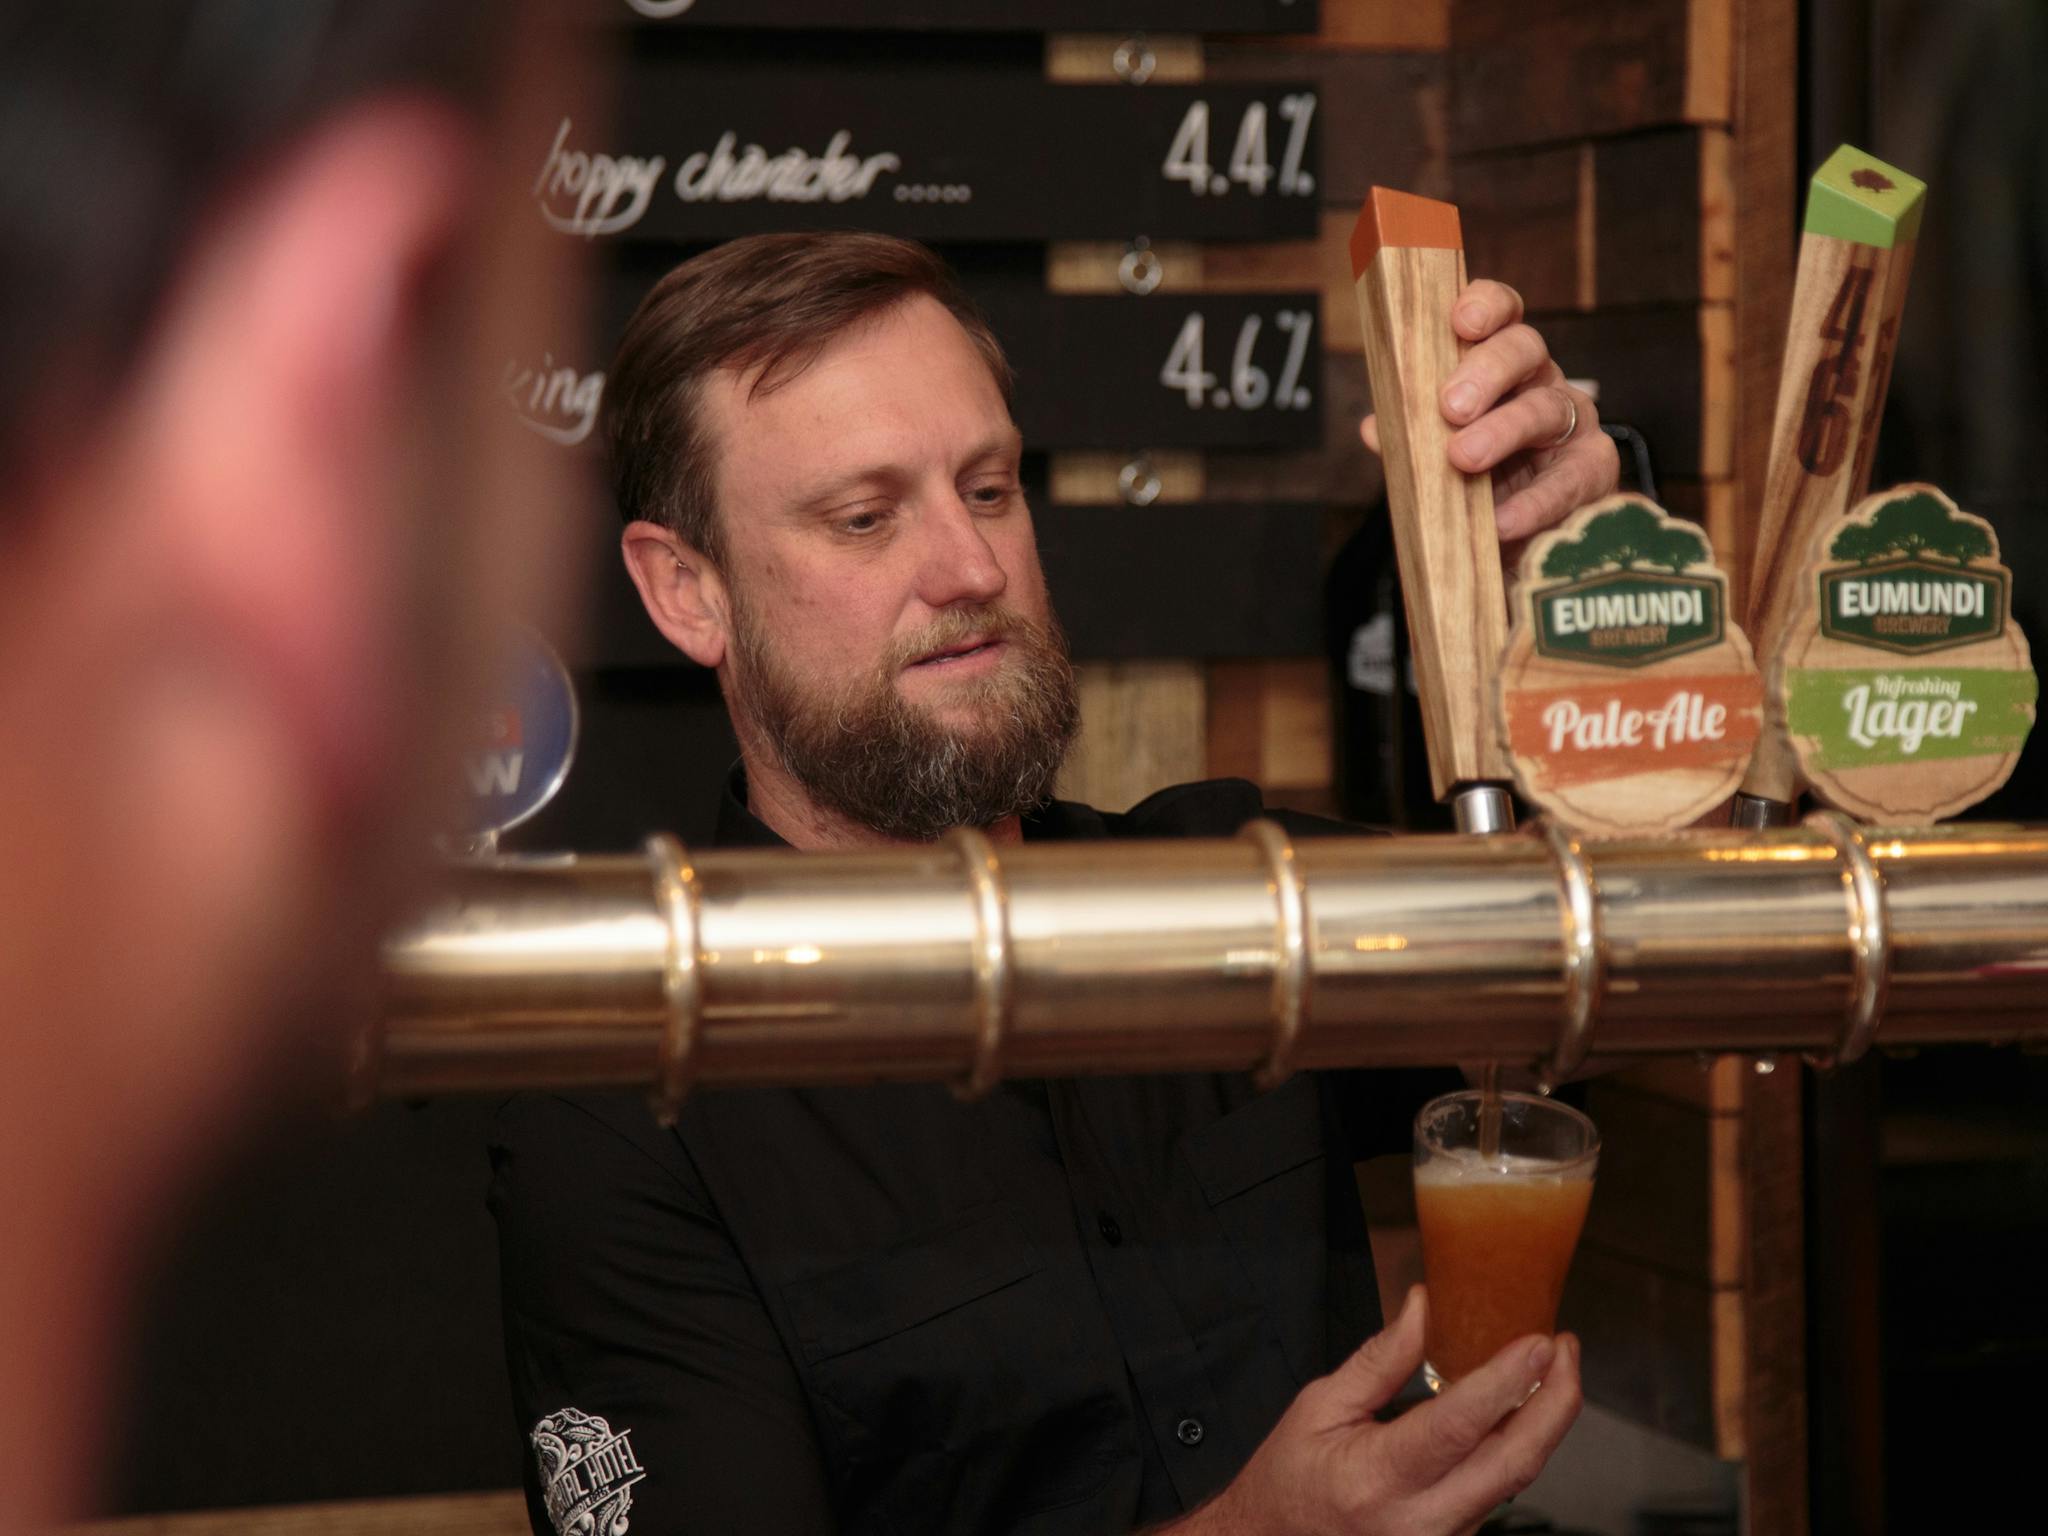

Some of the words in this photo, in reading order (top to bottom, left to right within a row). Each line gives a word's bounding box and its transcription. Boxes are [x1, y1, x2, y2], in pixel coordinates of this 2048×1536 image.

[533, 118, 666, 239] hoppy
[1162, 92, 1317, 197] 4.4%
[1160, 310, 1313, 411] 4.6%
[1552, 589, 1703, 636] EUMUNDI
[1838, 581, 1985, 618] EUMUNDI
[1873, 615, 1952, 635] BREWERY
[1589, 624, 1669, 648] BREWERY
[1873, 675, 1961, 699] Refreshing
[1542, 698, 1645, 752] Pale
[1639, 691, 1727, 750] Ale
[1842, 685, 1977, 754] Lager
[585, 1435, 644, 1492] HOTEL
